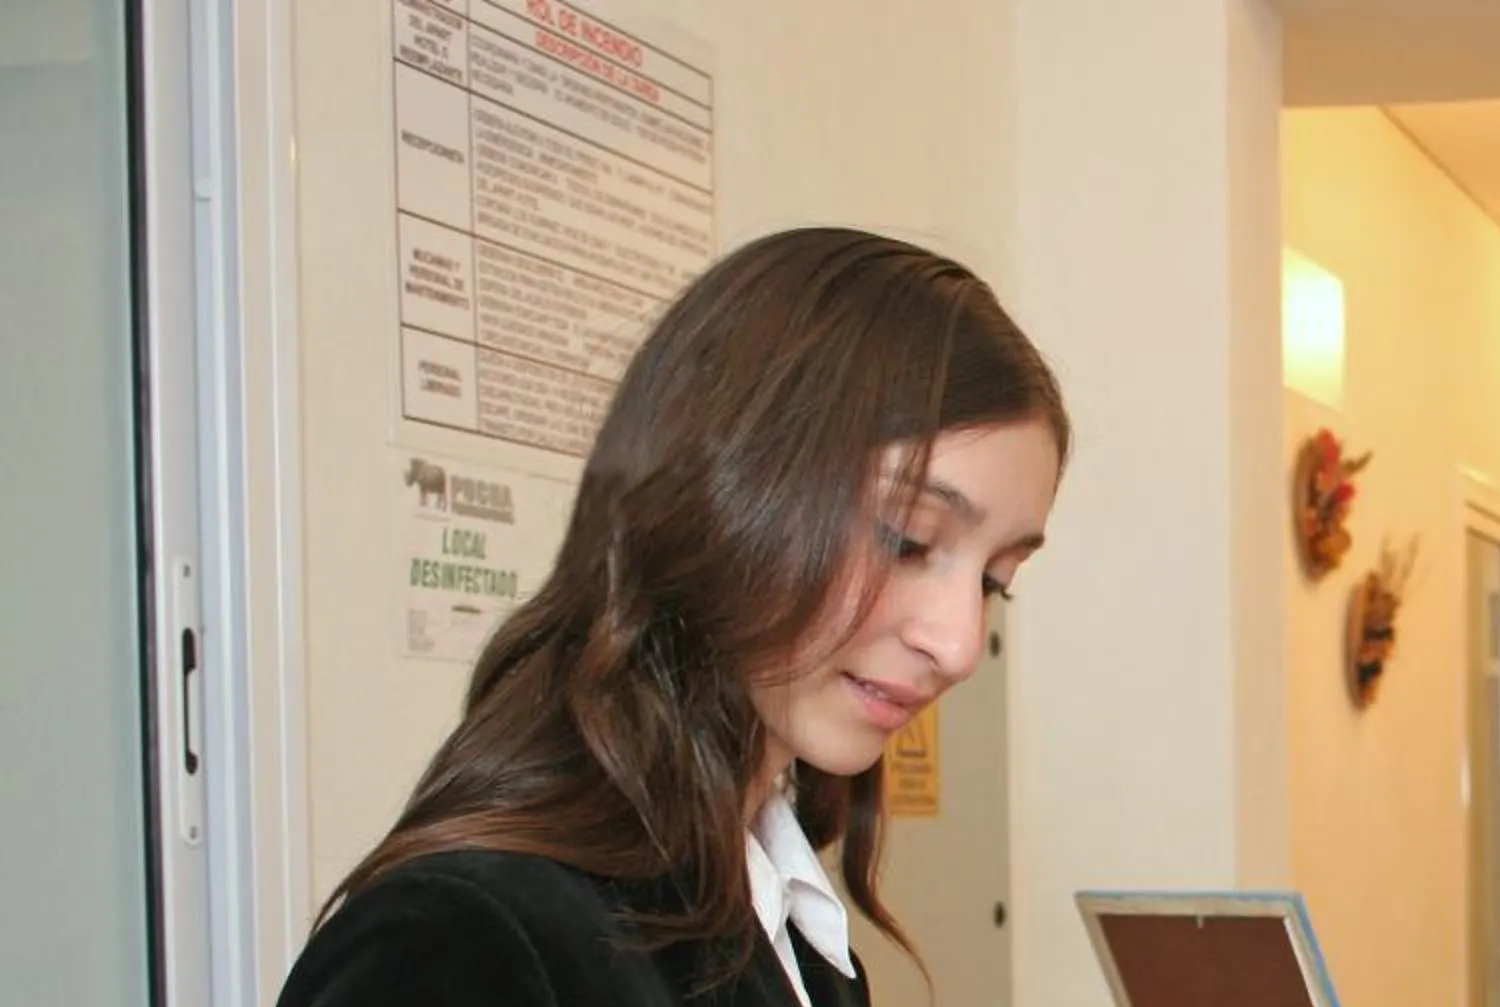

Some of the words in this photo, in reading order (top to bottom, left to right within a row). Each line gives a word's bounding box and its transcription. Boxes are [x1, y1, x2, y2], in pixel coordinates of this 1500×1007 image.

[558, 9, 578, 37] DE
[580, 20, 643, 69] INCENDIO
[442, 527, 487, 560] LOCAL
[410, 557, 518, 600] DESINFECTADO
